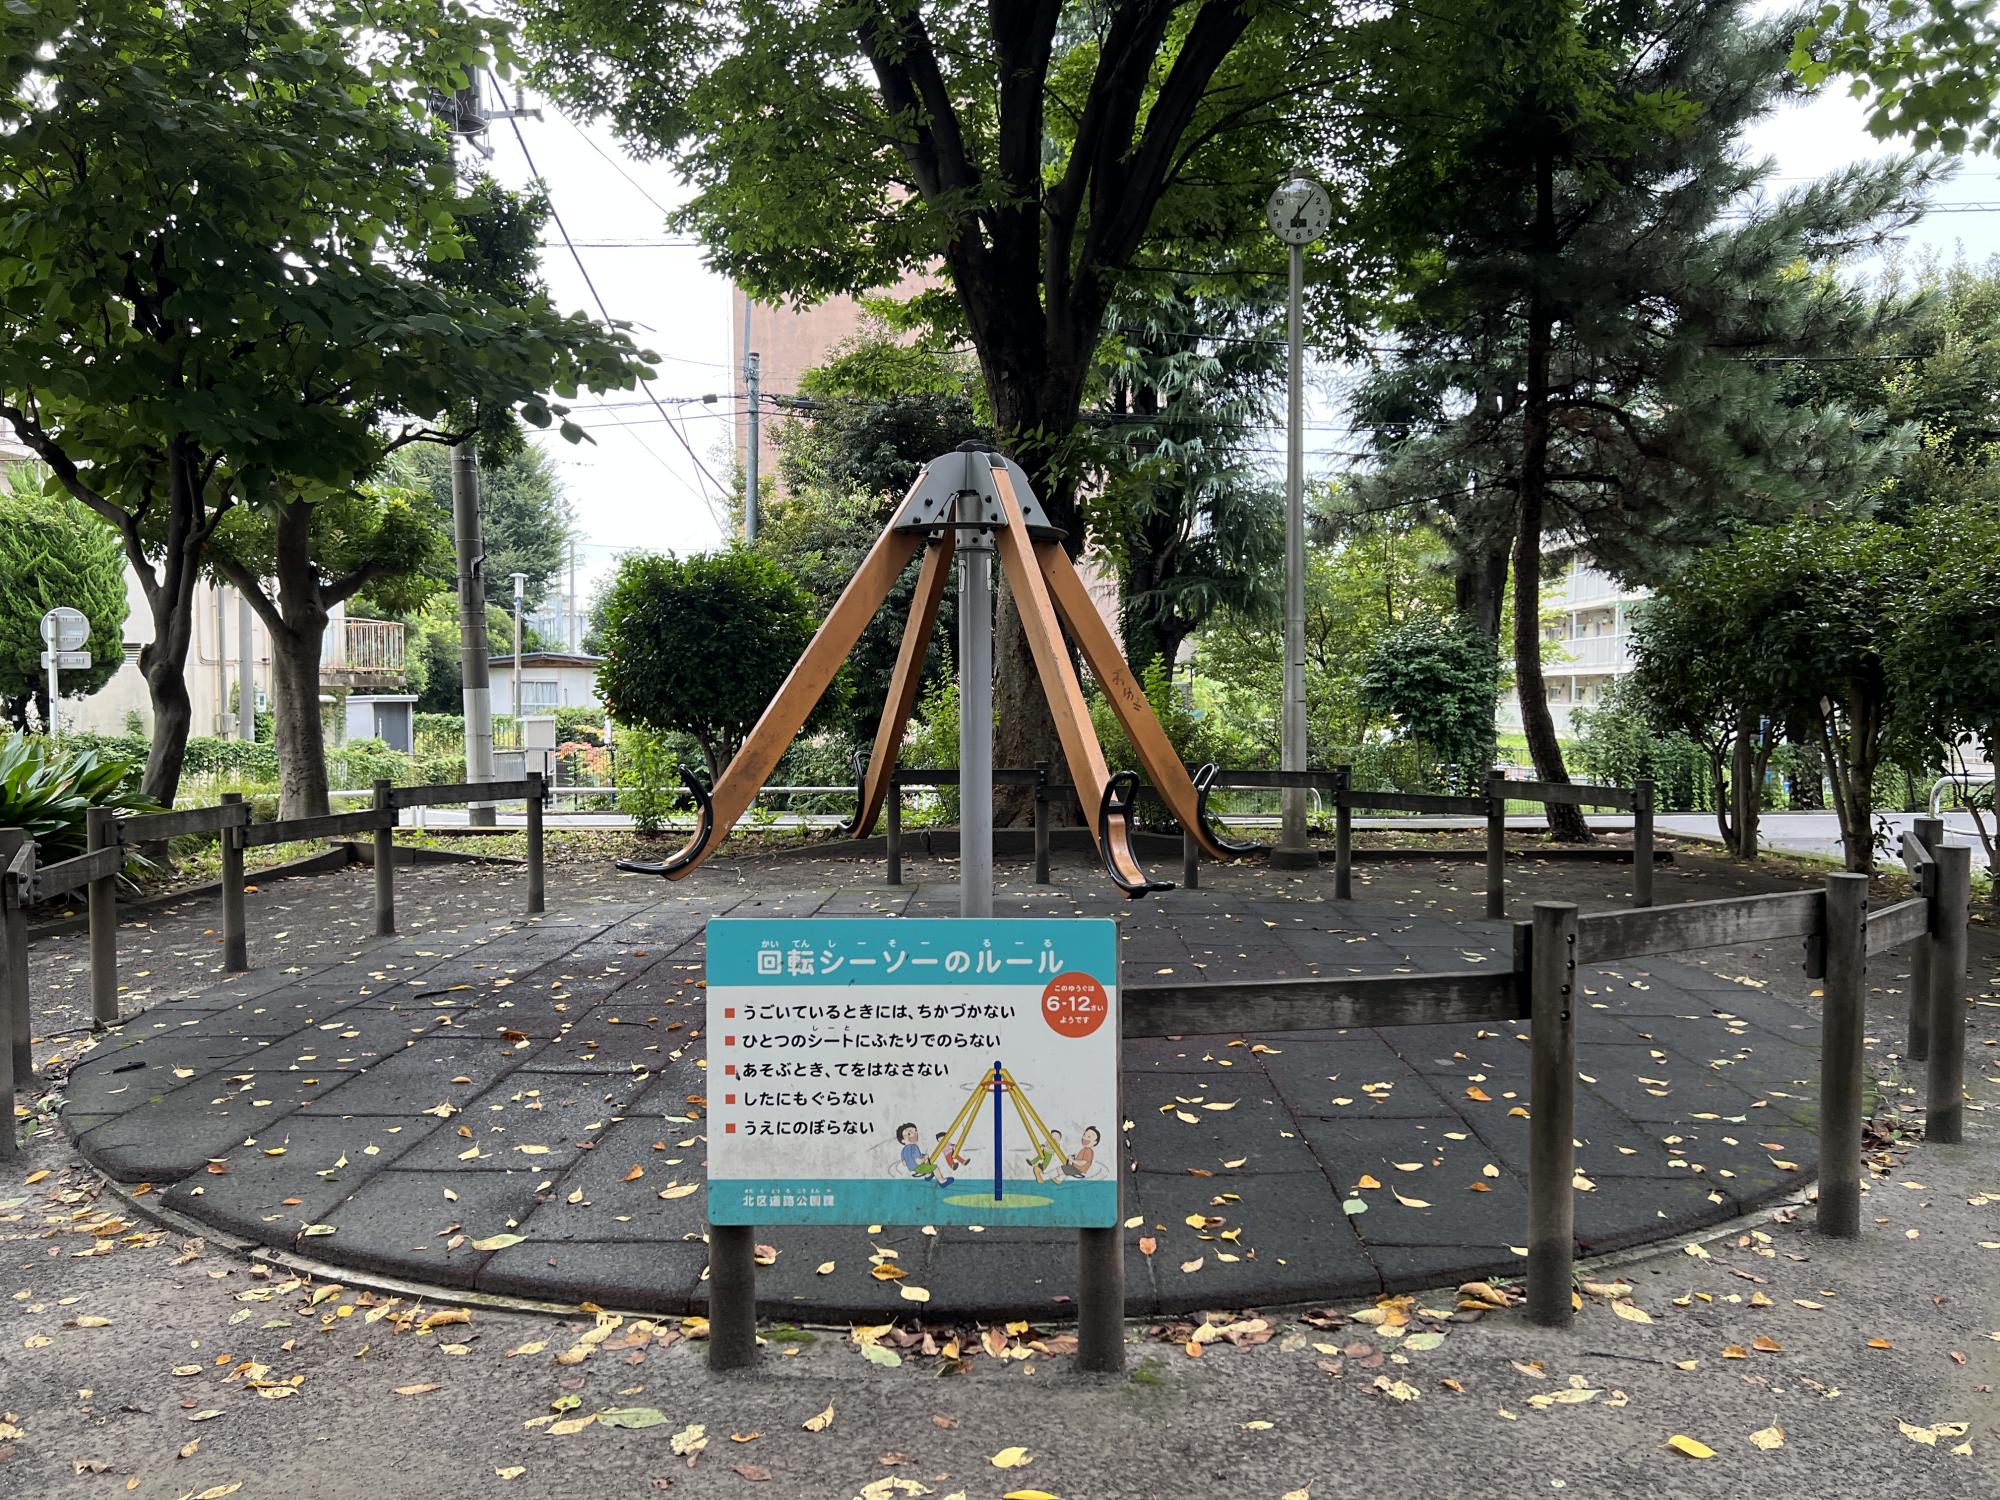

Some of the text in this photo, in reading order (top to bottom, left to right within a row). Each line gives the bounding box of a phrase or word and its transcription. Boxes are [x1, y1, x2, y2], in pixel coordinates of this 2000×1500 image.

[757, 949, 1064, 977] 回転シーソーのルール
[744, 1003, 1015, 1020] うごいているときには、ちかづかない
[1060, 1016, 1089, 1024] ようです
[742, 1033, 1001, 1048] ひとつのシートにふたりでのらない
[744, 1091, 874, 1106] したにもぐらない
[744, 1120, 875, 1136] うえにのぼらない
